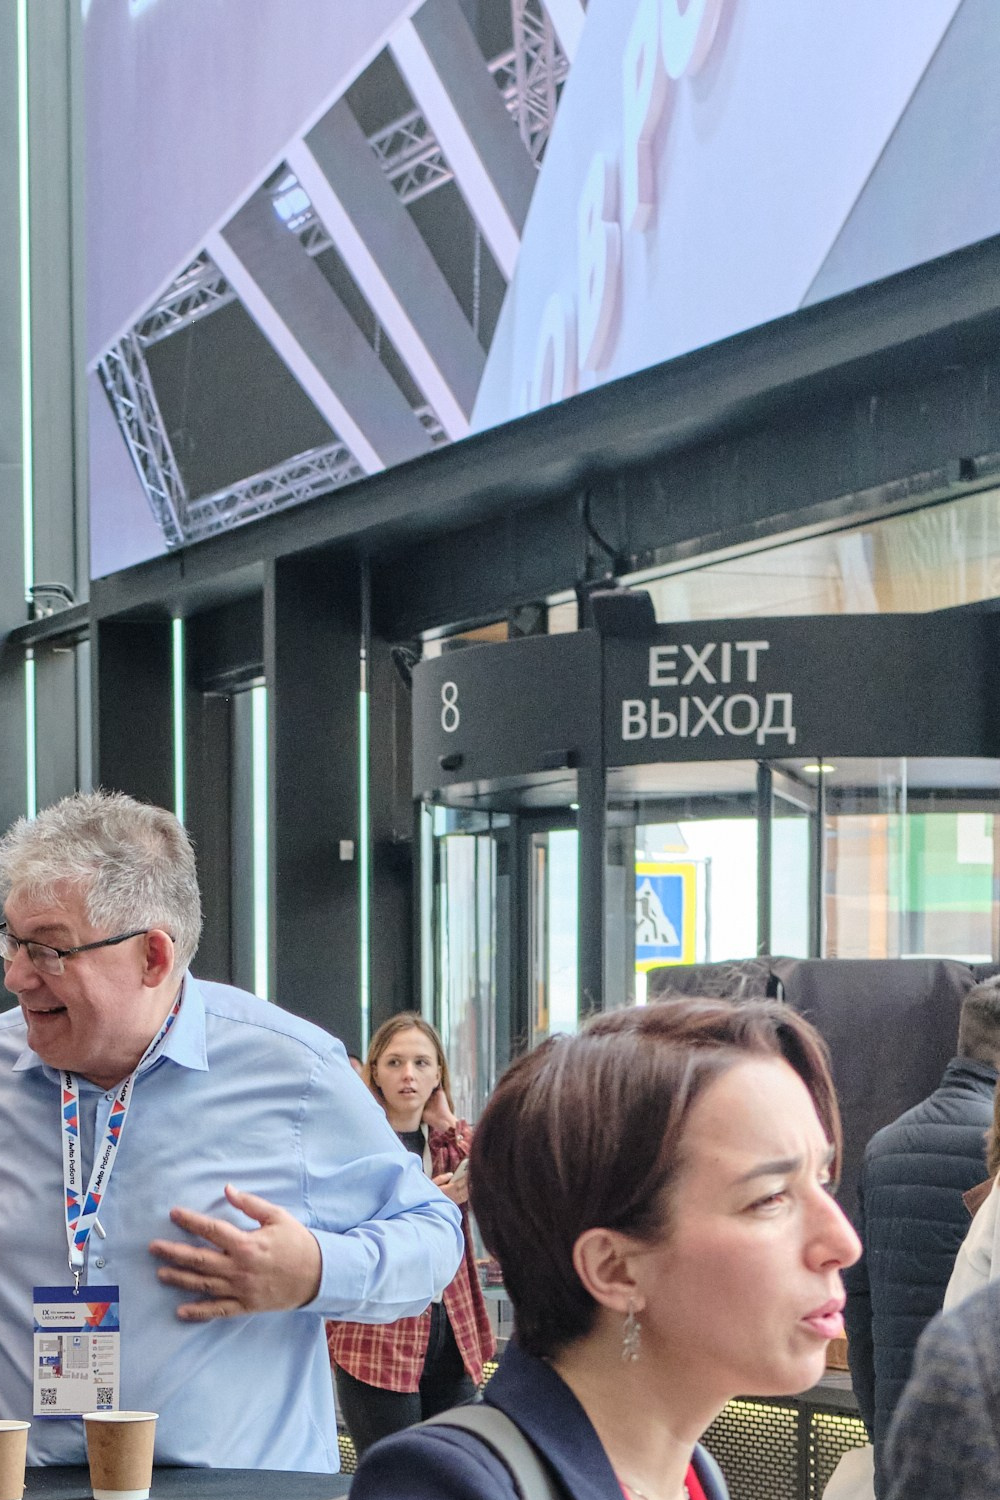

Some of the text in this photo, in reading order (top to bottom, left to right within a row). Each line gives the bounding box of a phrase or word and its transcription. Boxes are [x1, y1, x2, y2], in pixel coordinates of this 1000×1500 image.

[648, 640, 770, 687] EXIT
[440, 681, 461, 733] 8
[621, 693, 796, 745] ВЫХОД
[95, 1144, 113, 1187] Avito Работа
